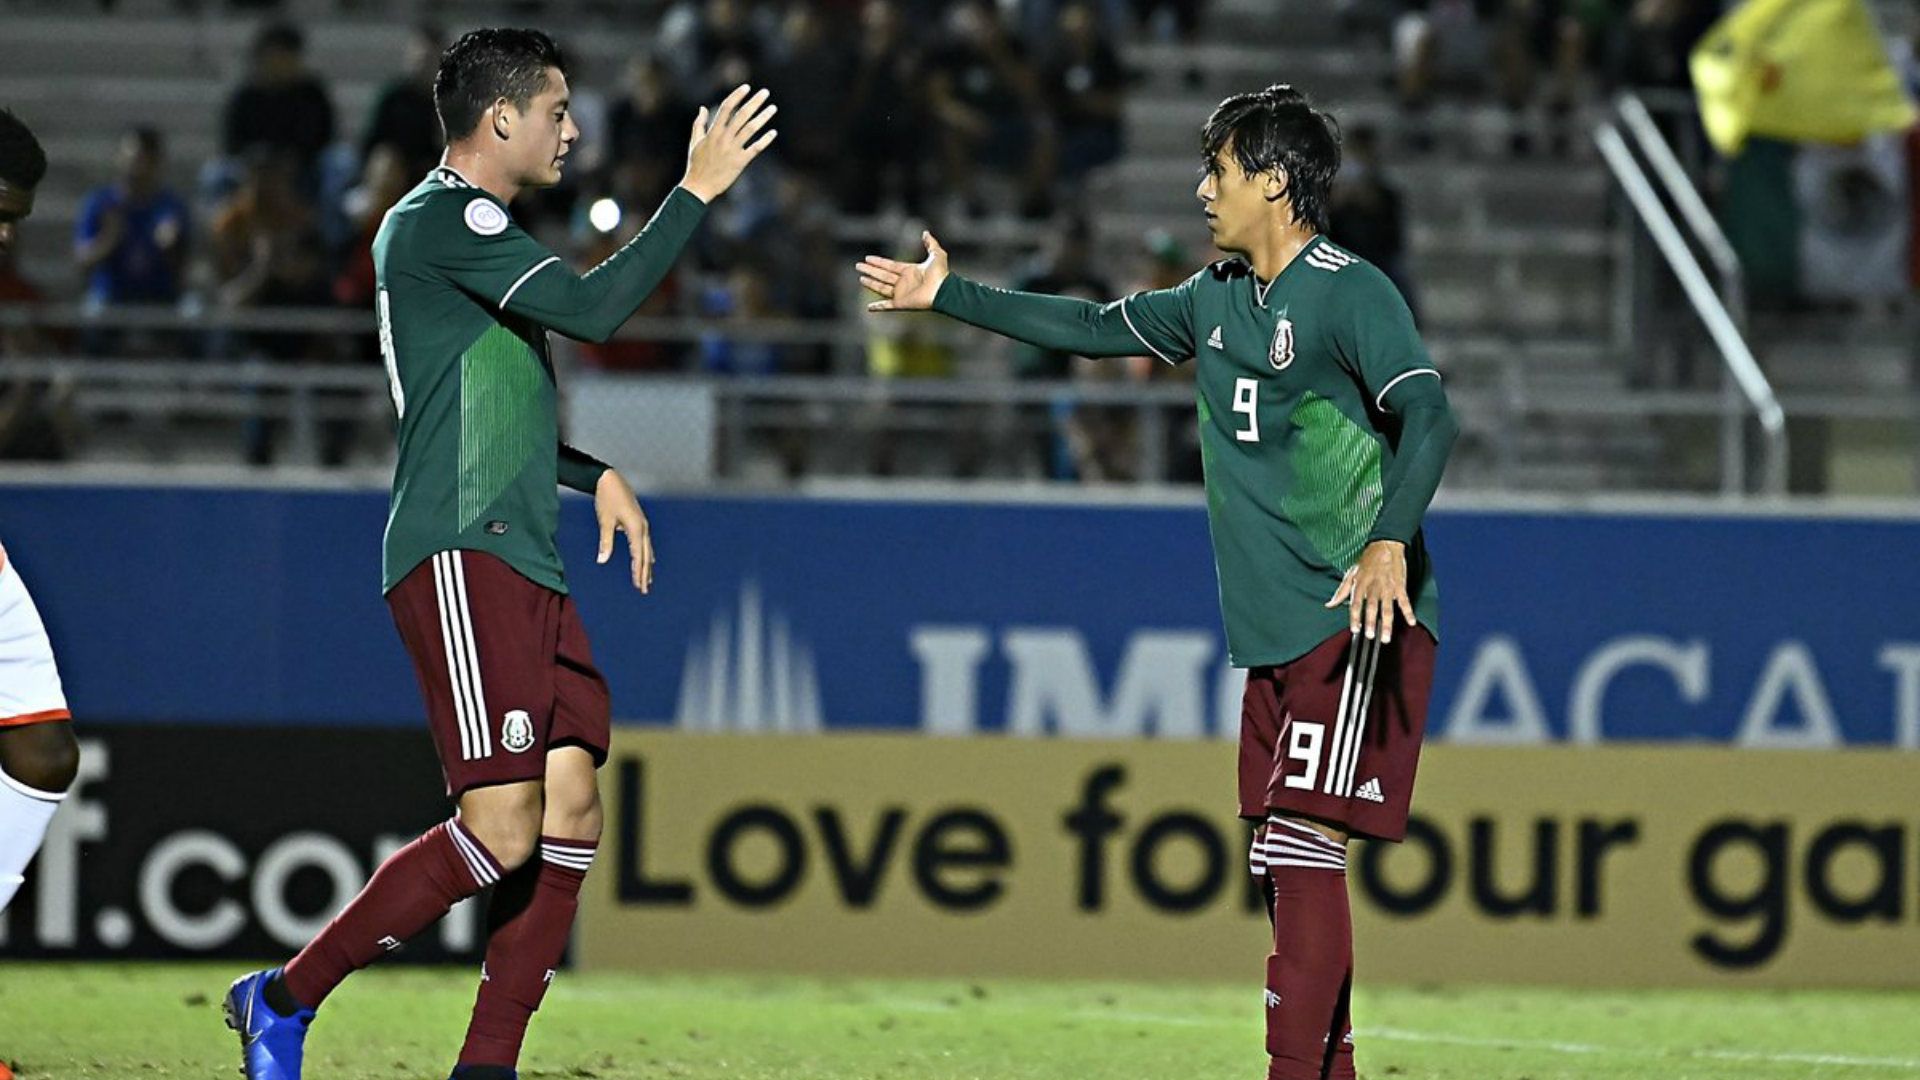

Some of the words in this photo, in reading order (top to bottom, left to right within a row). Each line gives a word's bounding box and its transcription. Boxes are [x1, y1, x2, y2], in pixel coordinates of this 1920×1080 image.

[1232, 377, 1260, 442] 9
[909, 625, 1246, 738] IM
[1284, 721, 1325, 790] 9
[616, 756, 1012, 914] Love
[1359, 814, 1640, 921] our
[1687, 814, 1920, 969] ga
